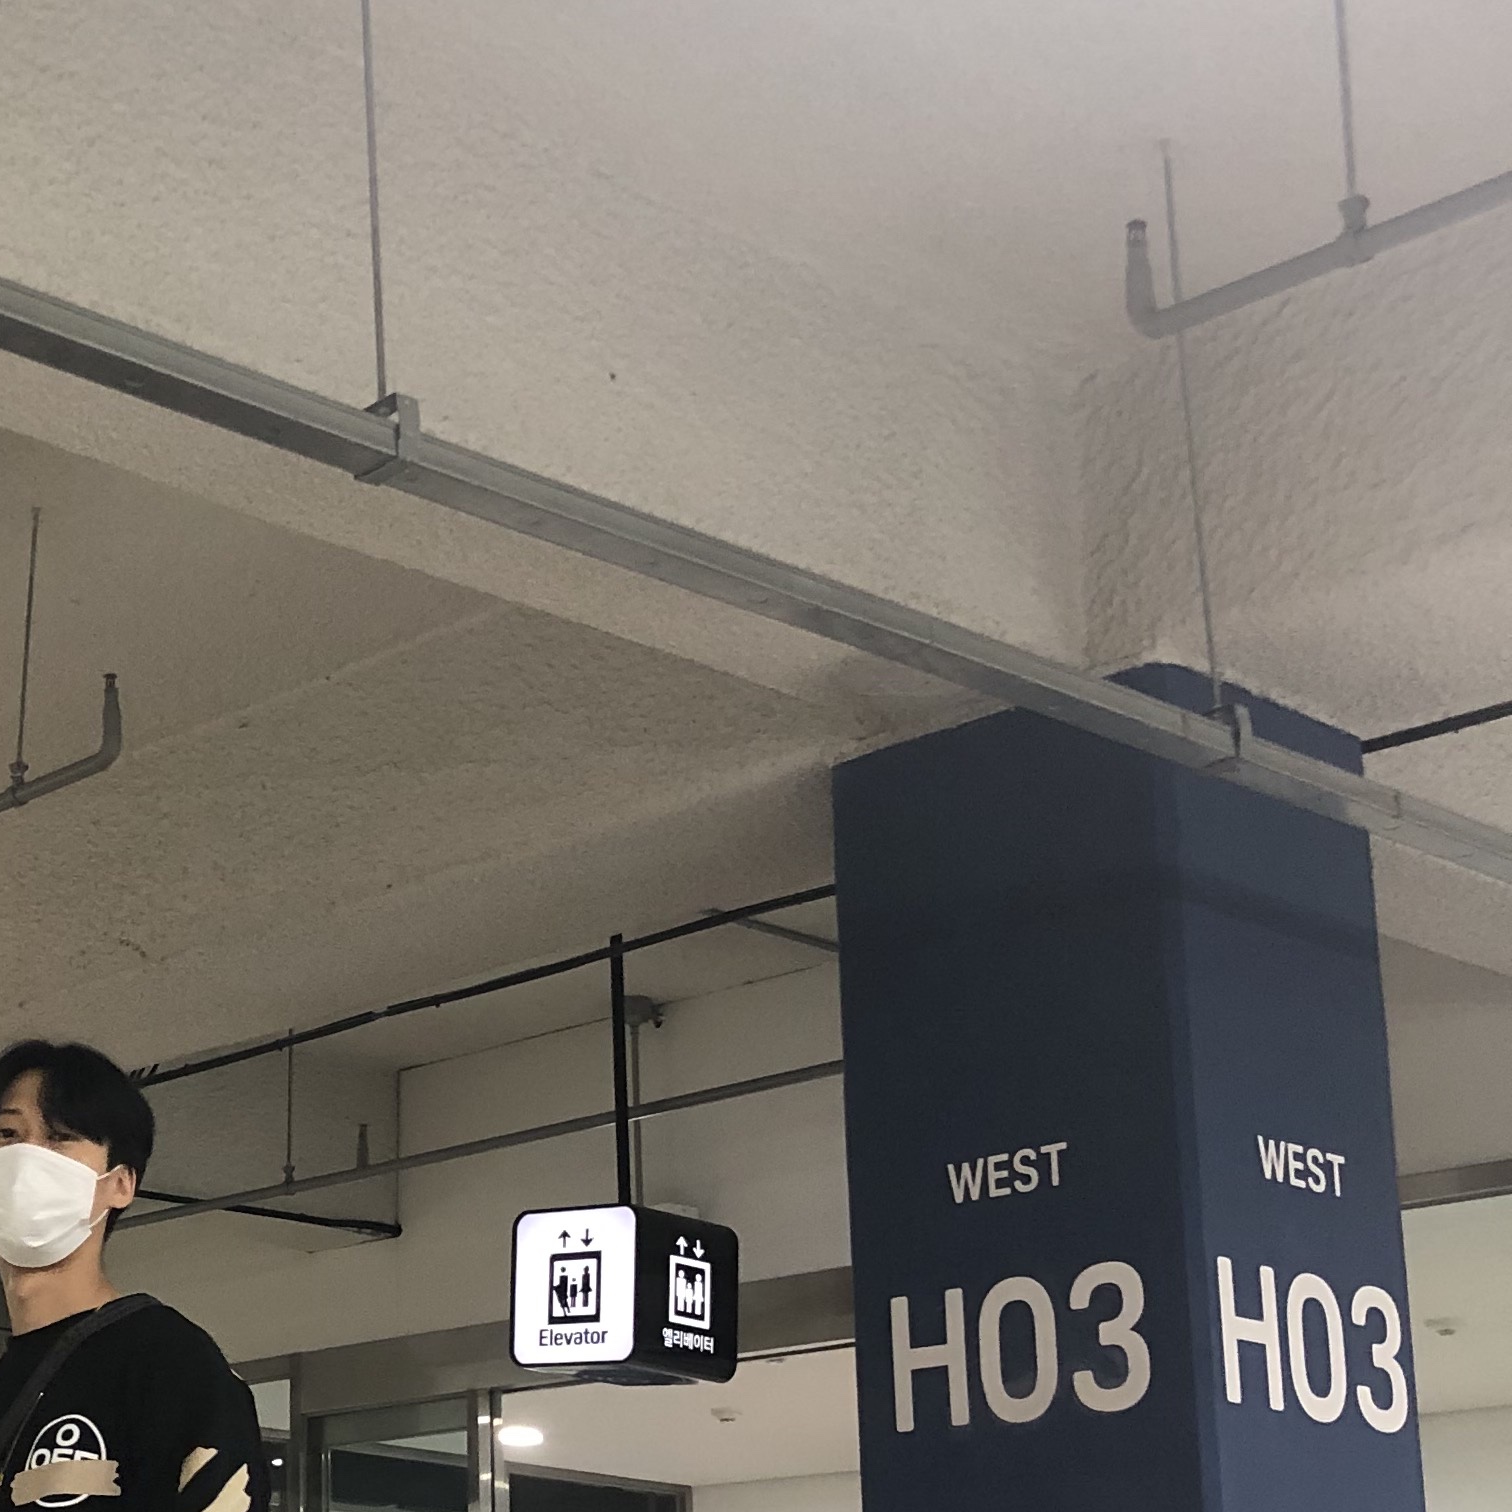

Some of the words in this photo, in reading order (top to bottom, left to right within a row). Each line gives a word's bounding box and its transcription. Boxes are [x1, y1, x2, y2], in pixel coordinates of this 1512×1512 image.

[946, 1141, 1069, 1205] WEST
[1256, 1134, 1346, 1198] WEST
[538, 1328, 609, 1348] Elevator
[662, 1327, 714, 1354] 엘리베이터
[889, 1259, 1152, 1433] H03
[1215, 1256, 1409, 1435] H03
